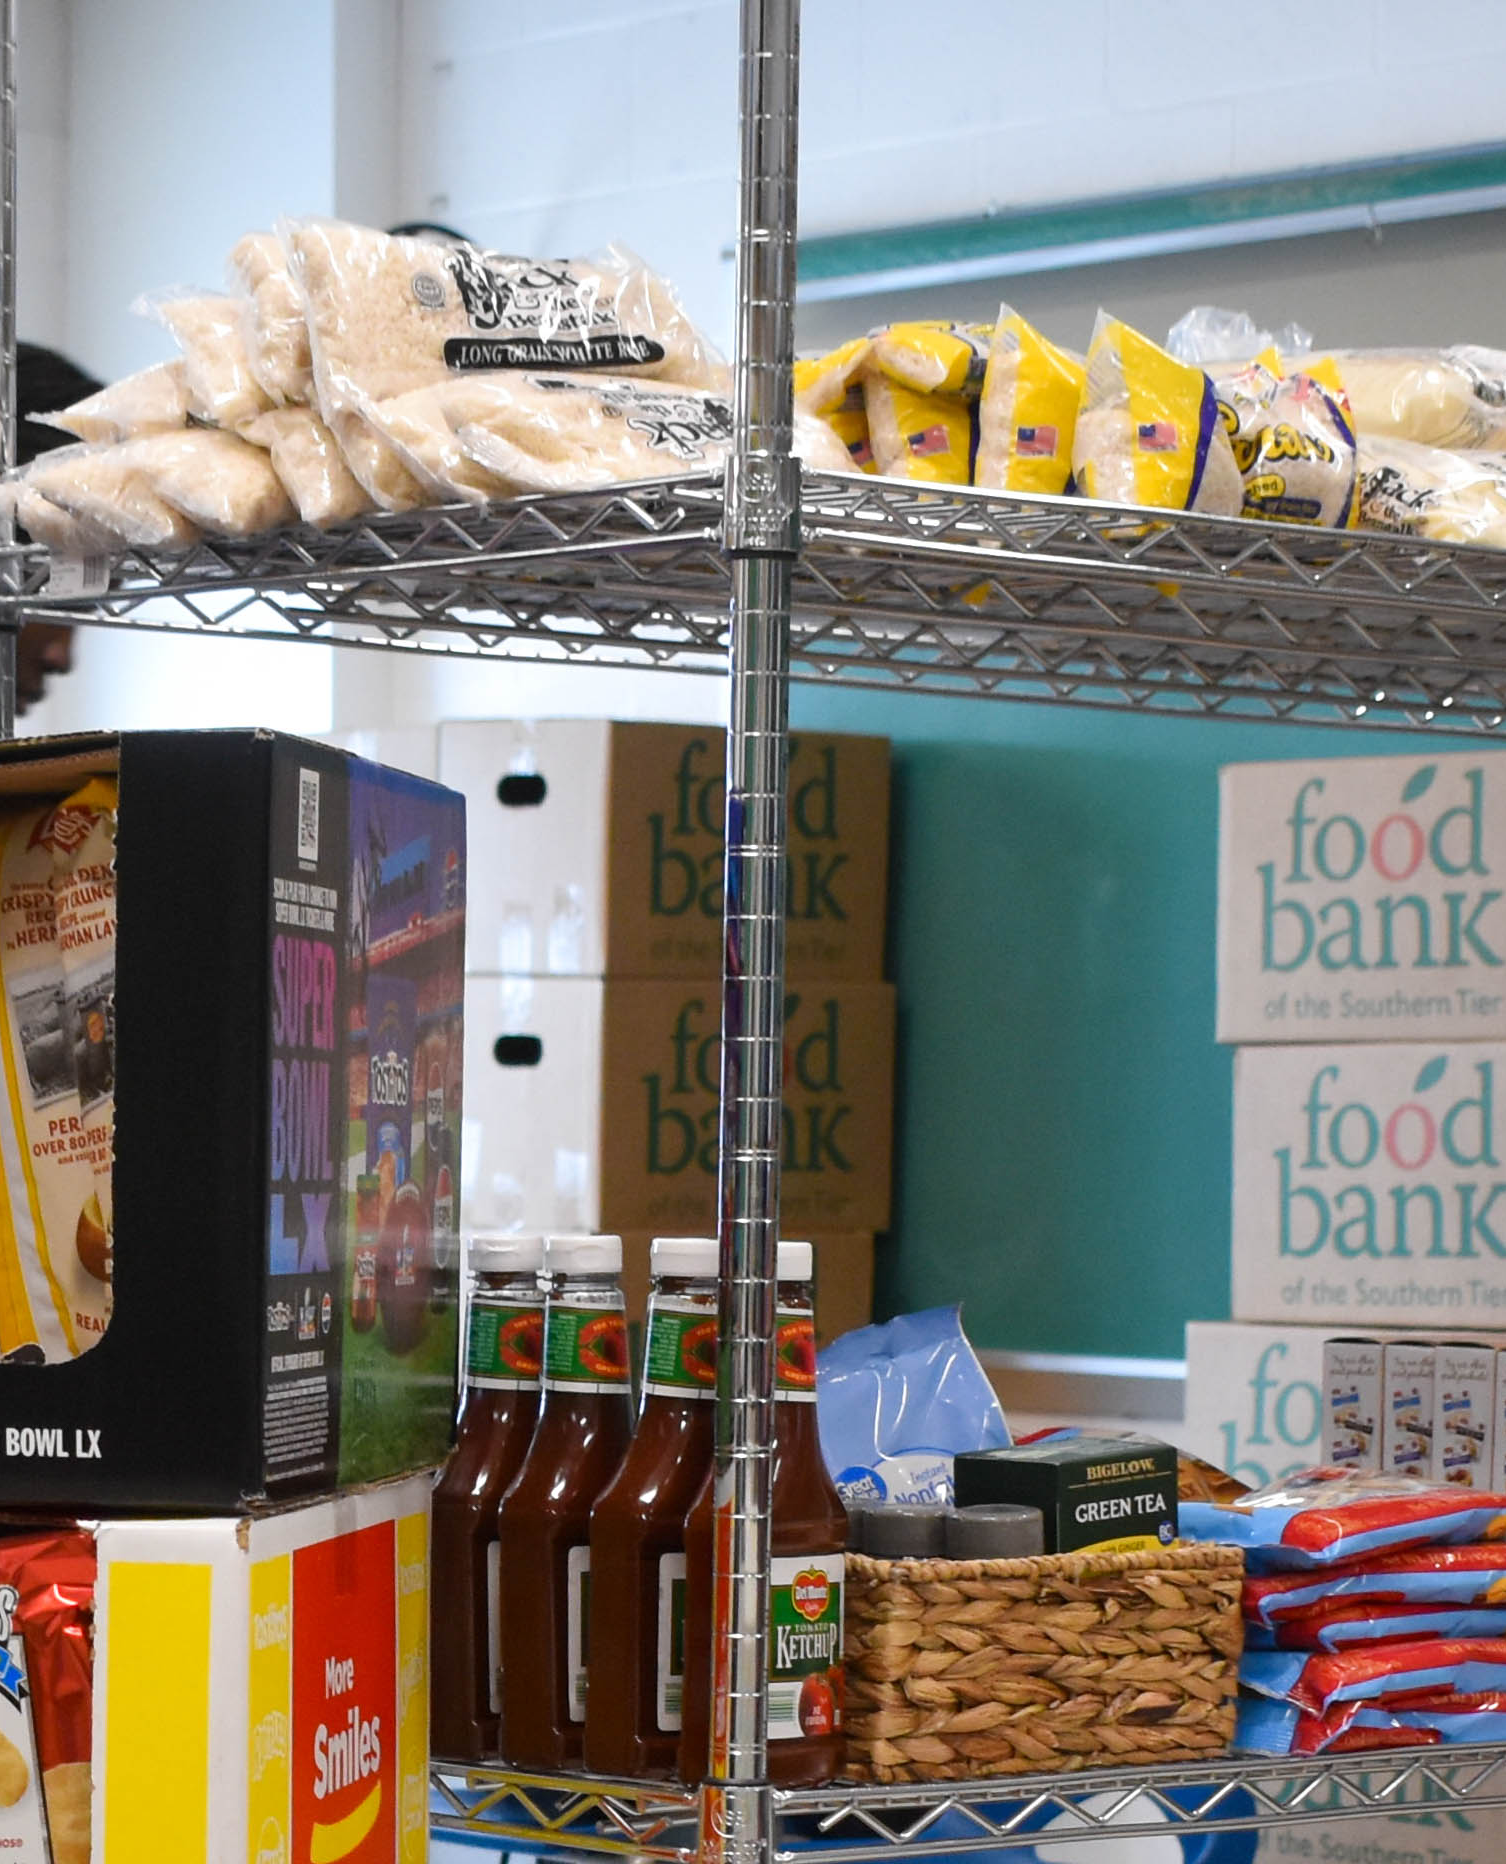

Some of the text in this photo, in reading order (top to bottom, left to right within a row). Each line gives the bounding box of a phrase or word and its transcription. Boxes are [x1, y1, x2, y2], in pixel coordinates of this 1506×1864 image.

[460, 344, 502, 365] LONG
[673, 738, 838, 841] fod
[1284, 770, 1492, 884] food
[647, 813, 851, 921] bak
[1257, 862, 1506, 974] bank
[272, 933, 338, 1050] SUPER
[1264, 988, 1503, 1021] of the Southern Tier
[642, 1075, 853, 1176] bak
[1300, 1060, 1502, 1170] food
[268, 1193, 331, 1276] LX
[1309, 1279, 1348, 1306] the
[1354, 1278, 1463, 1308] Southern
[5, 1426, 70, 1458] BOWL
[76, 1429, 103, 1459] LX
[1086, 1457, 1155, 1481] BIGELOW
[837, 1477, 875, 1498] Great
[1074, 1493, 1167, 1526] GREEN TEA
[325, 1656, 354, 1699] More
[776, 1622, 838, 1670] KETCHUP
[313, 1706, 381, 1800] Smiles
